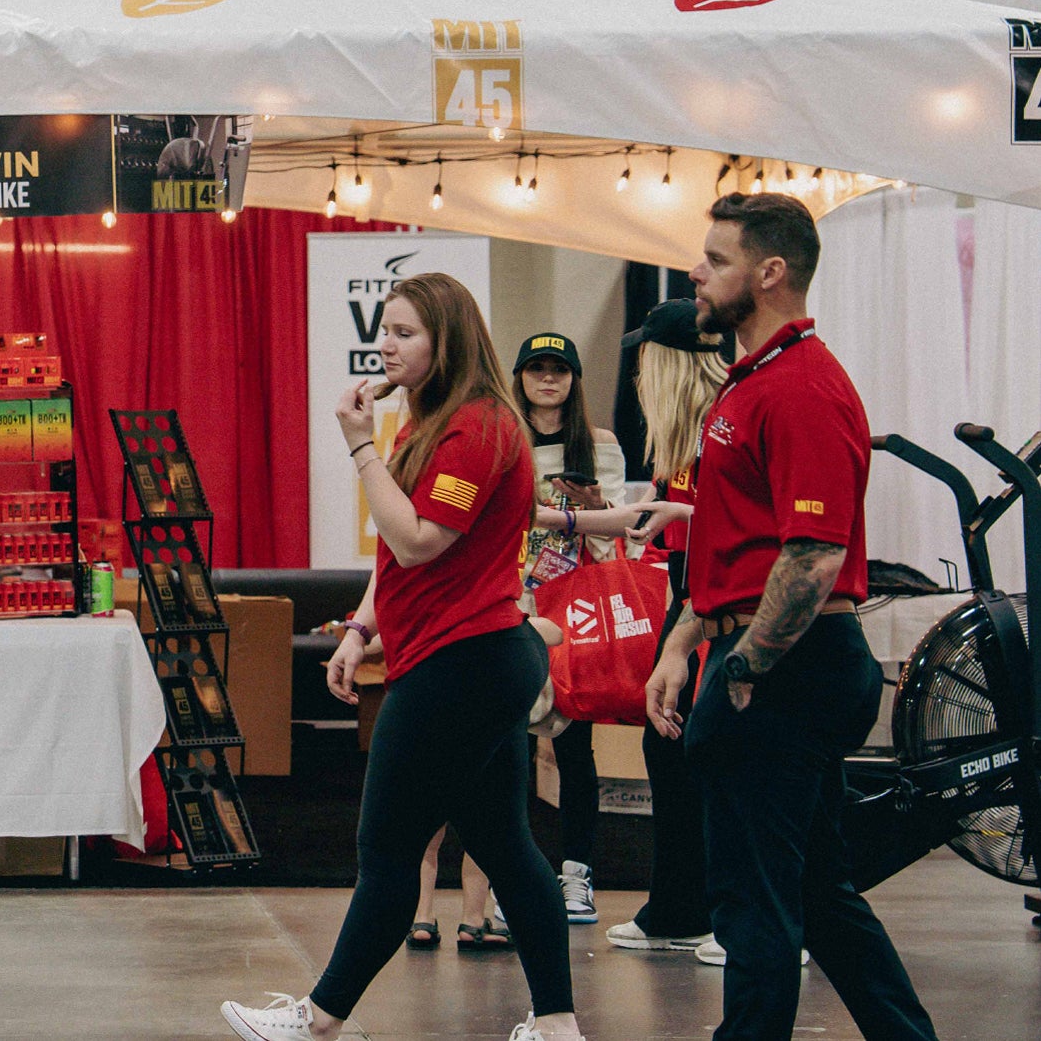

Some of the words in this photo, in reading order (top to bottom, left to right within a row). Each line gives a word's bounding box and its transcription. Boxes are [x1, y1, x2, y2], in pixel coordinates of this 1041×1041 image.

[444, 69, 513, 128] 45
[152, 181, 194, 210] MIT
[961, 757, 991, 778] ECHO
[992, 748, 1019, 769] BIKE
